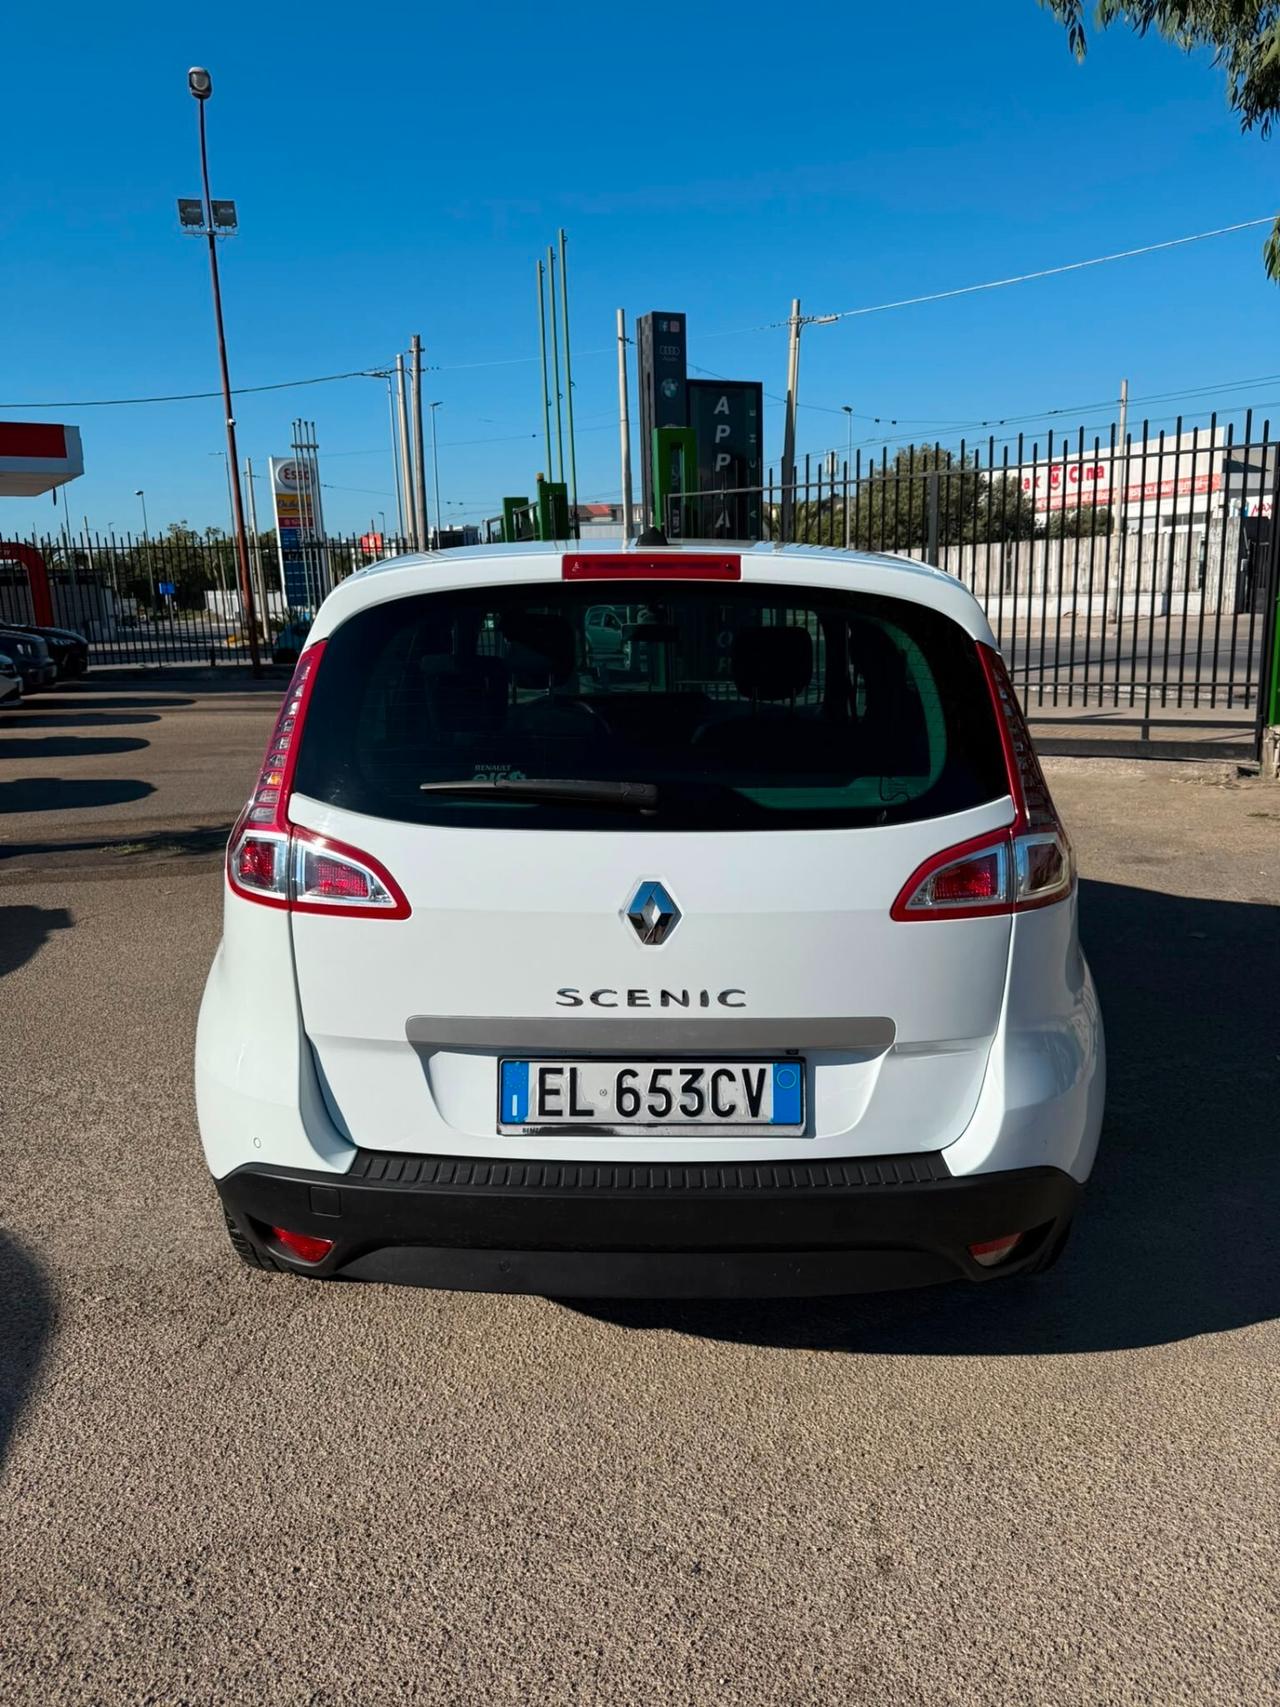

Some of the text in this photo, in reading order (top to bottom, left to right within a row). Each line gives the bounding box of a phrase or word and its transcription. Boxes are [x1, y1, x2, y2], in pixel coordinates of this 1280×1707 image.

[556, 988, 747, 1008] SCENIC
[537, 1066, 594, 1119] EL
[615, 1066, 767, 1120] 653CV
